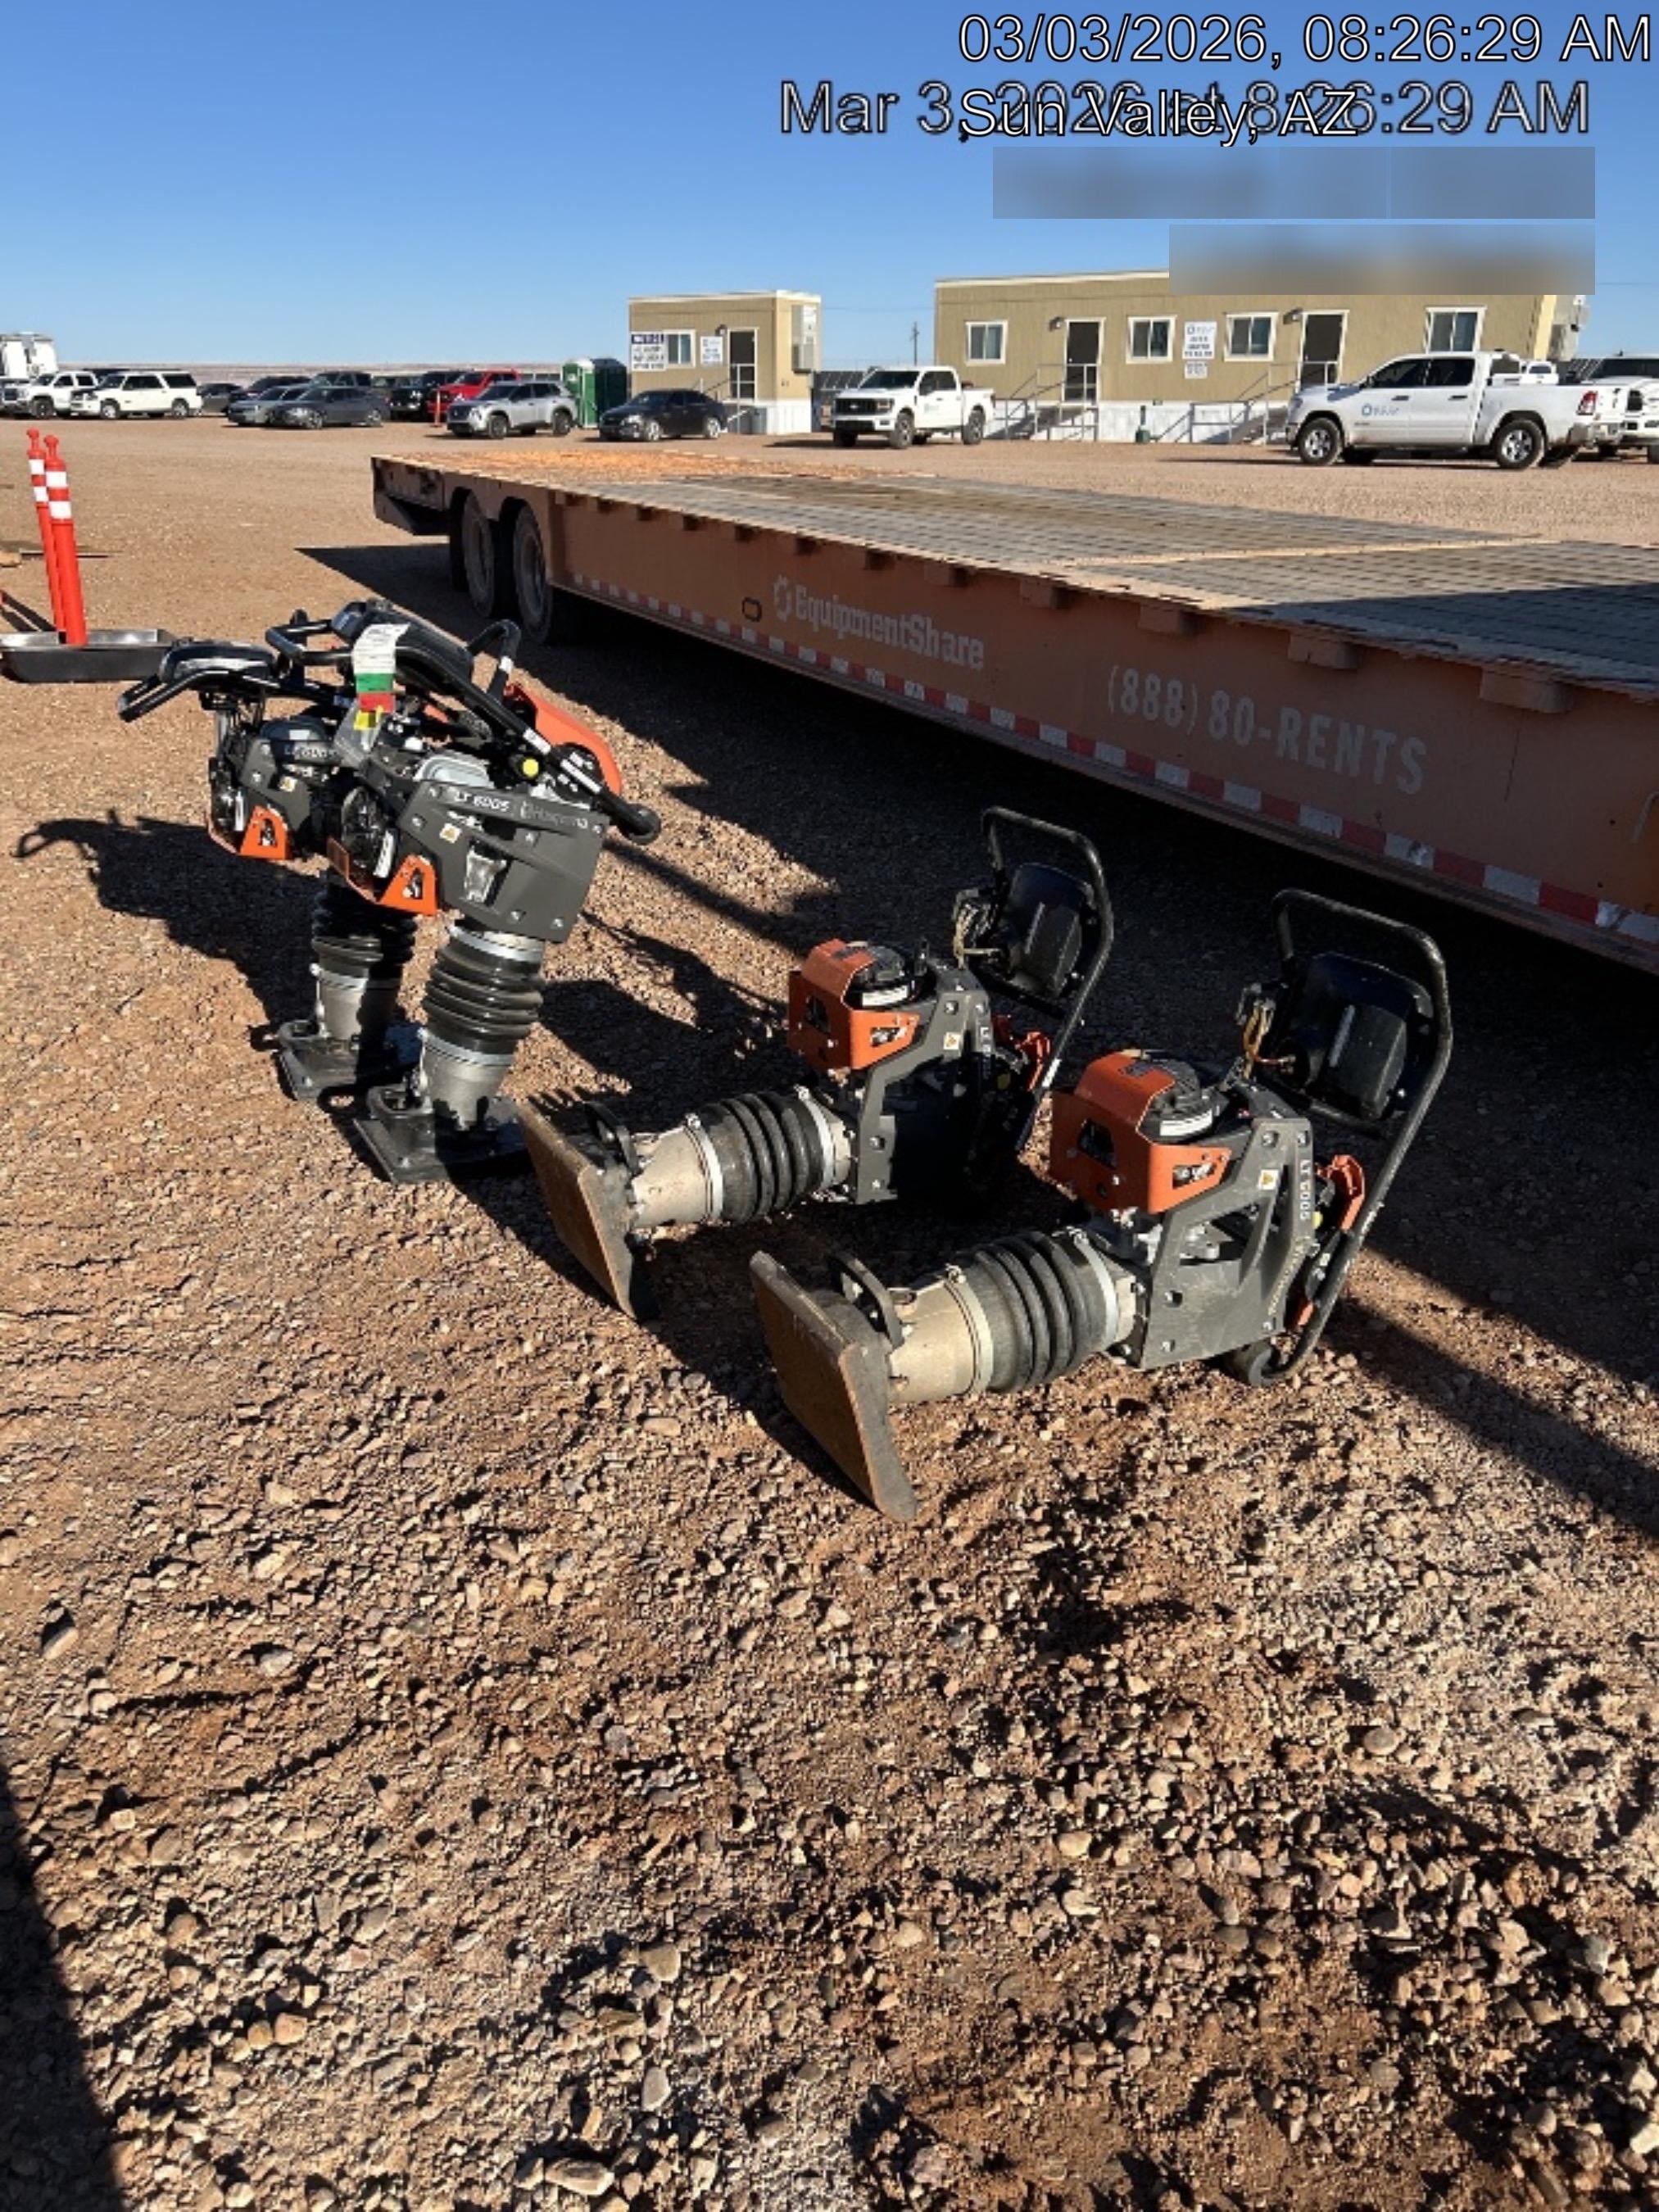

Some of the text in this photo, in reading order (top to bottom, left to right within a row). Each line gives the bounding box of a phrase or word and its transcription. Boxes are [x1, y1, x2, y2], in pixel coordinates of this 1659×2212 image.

[795, 584, 984, 669] EquipmentShare
[1108, 664, 1427, 796] (888) 80-RENTS
